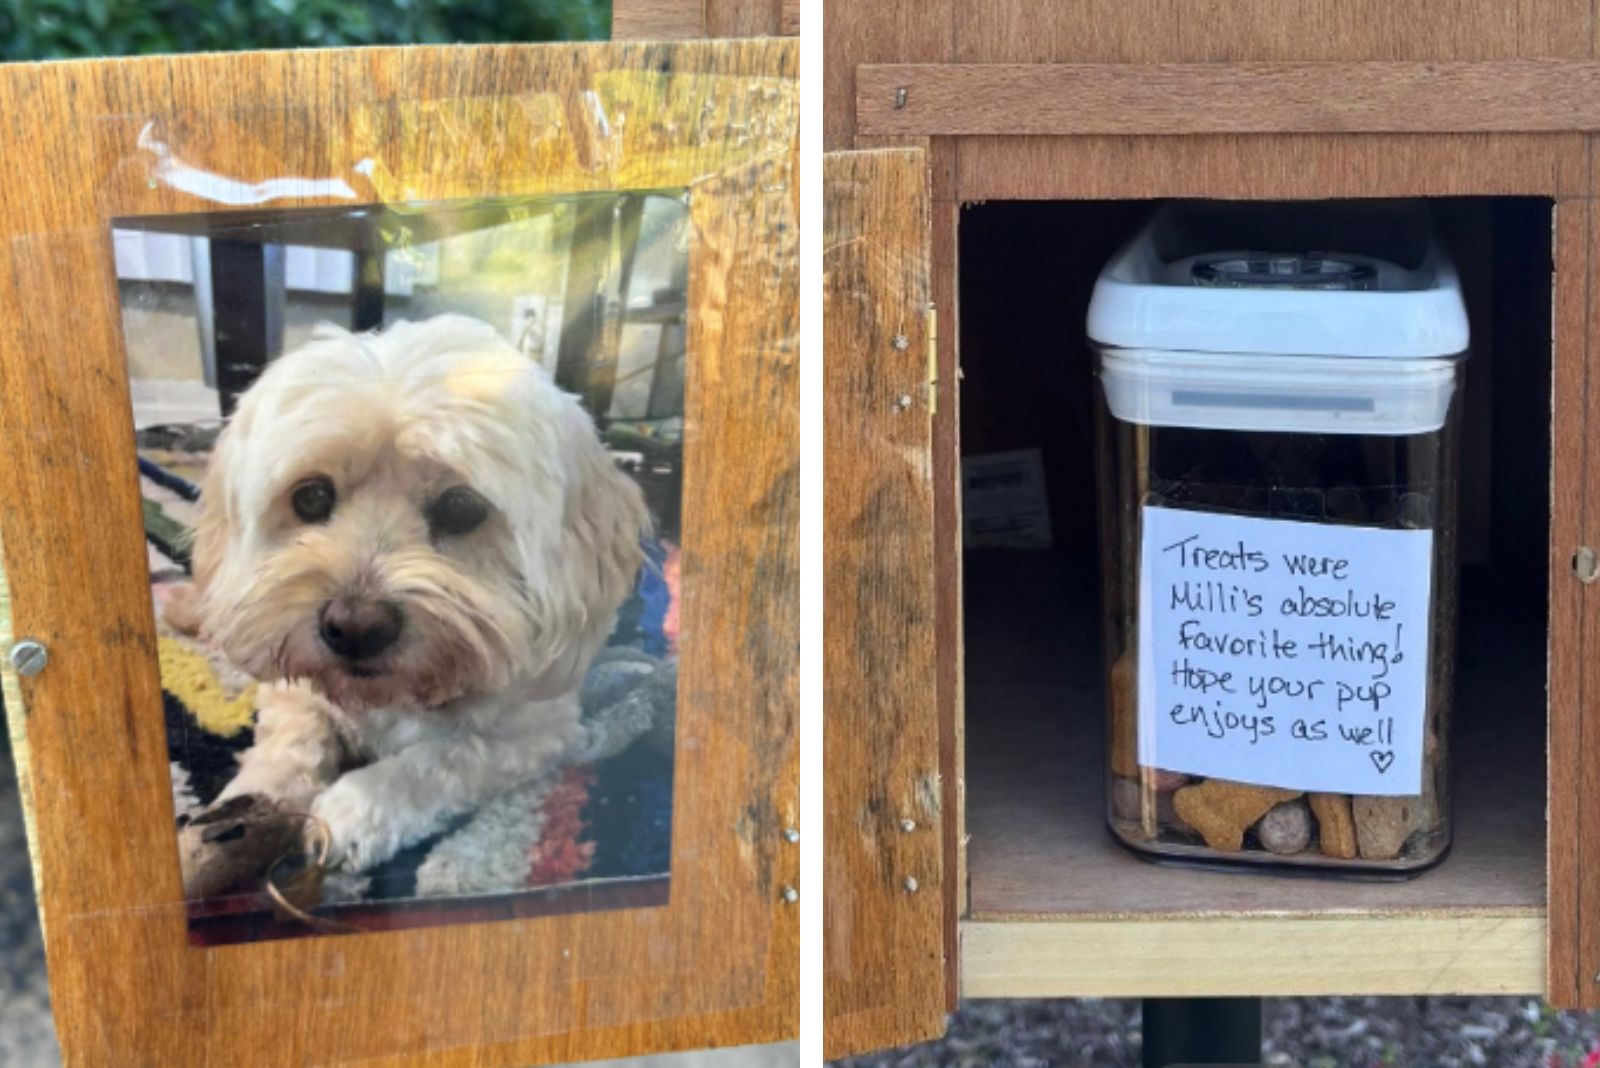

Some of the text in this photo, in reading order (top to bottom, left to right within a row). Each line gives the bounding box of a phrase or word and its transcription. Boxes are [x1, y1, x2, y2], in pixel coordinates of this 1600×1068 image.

[1162, 534, 1349, 580] Treats were
[1170, 581, 1396, 620] Milli's absolute
[1308, 623, 1404, 680] thing!
[1172, 658, 1392, 712] Hope your pup
[1170, 701, 1393, 746] enjoys as well
